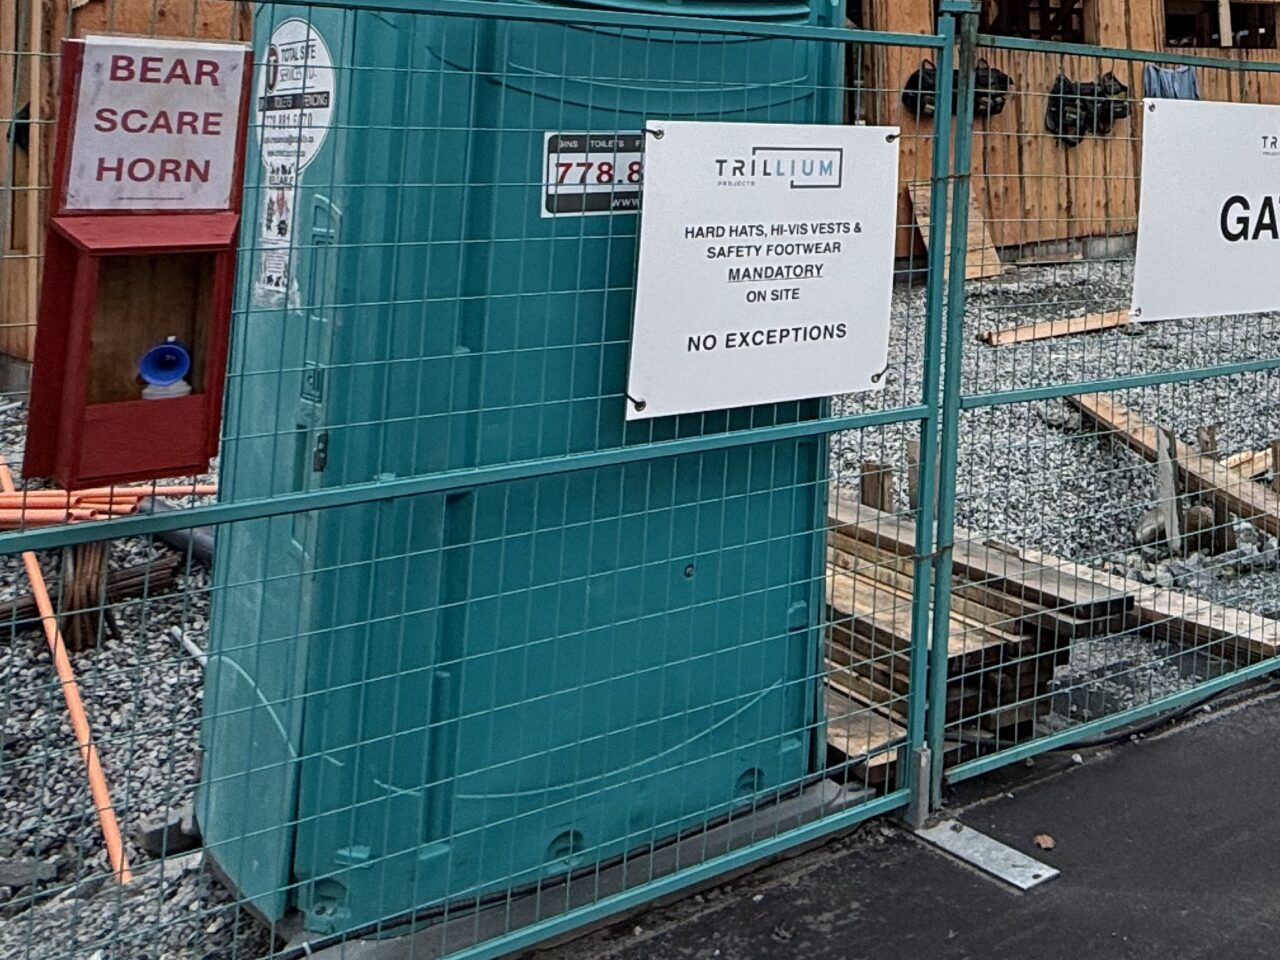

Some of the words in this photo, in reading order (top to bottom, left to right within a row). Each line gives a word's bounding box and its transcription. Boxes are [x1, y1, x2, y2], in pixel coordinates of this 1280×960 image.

[299, 44, 316, 60] STE
[109, 54, 220, 87] BEAR
[94, 107, 223, 136] SCARE
[96, 157, 211, 183] HORN
[715, 159, 833, 177] TRILLIUM
[684, 226, 726, 240] HARD
[728, 224, 768, 239] HATS,
[770, 222, 809, 237] HI-VIS
[810, 221, 851, 235] VESTS
[853, 221, 863, 234] &
[706, 244, 762, 259] SAFETY
[765, 241, 842, 257] FOOTWEAR
[727, 264, 824, 282] MANDATORY
[746, 289, 767, 303] ON
[770, 287, 801, 301] SITE
[687, 334, 717, 352] NO
[725, 322, 848, 349] EXCEPTIONS
